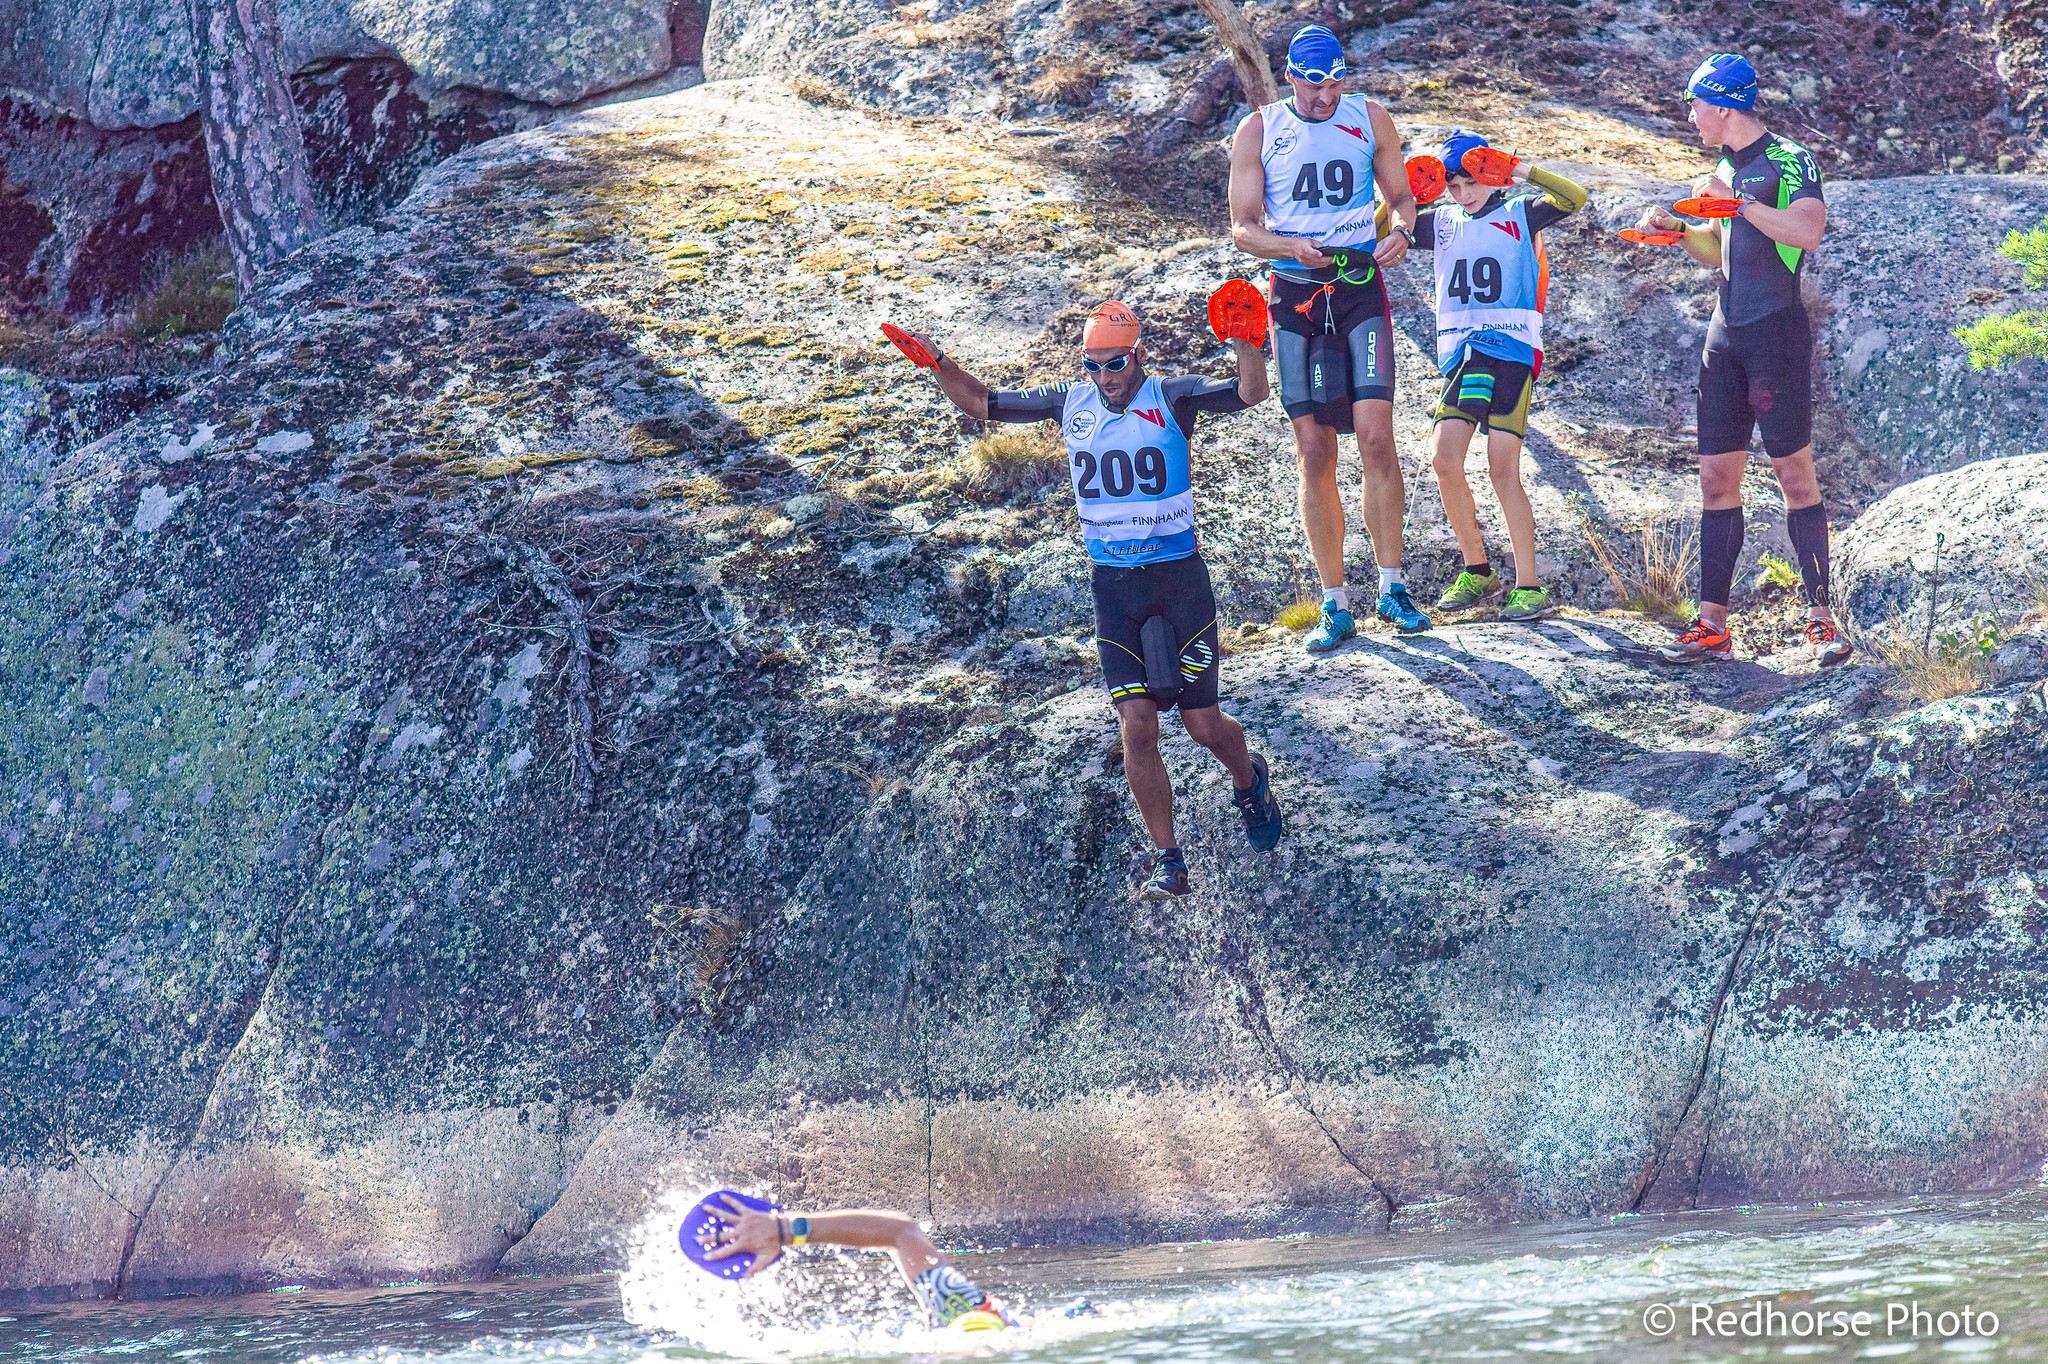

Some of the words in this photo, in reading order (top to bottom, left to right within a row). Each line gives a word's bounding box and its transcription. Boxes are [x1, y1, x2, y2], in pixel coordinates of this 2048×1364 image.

[1292, 159, 1354, 209] 49
[1448, 257, 1503, 305] 49
[1367, 331, 1376, 377] HEAD
[1074, 447, 1167, 499] 209
[1132, 507, 1188, 526] FINNHAMN
